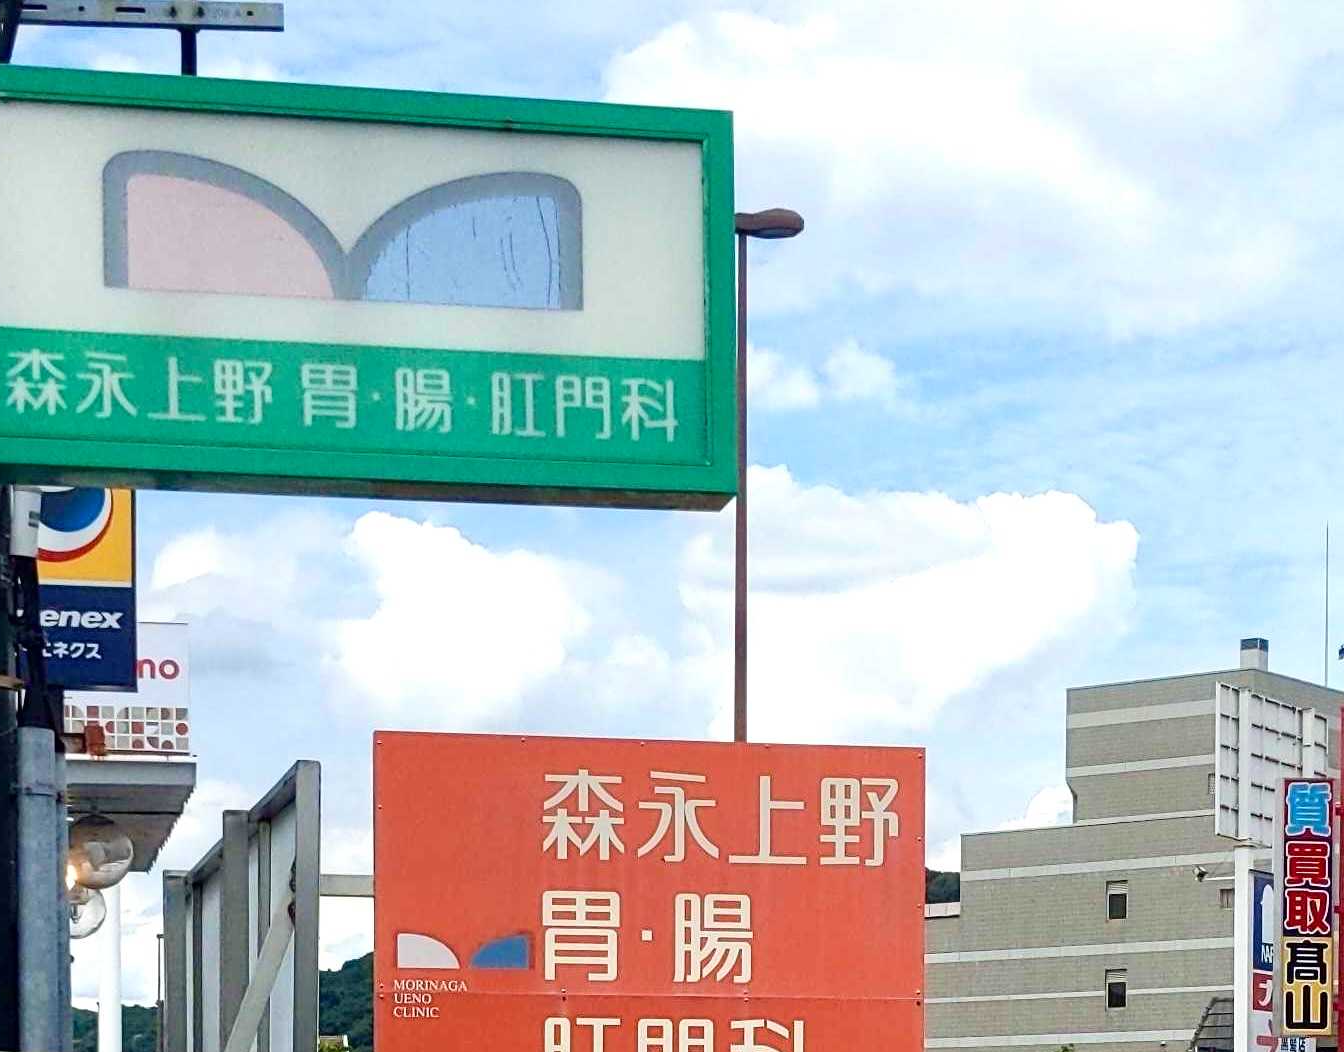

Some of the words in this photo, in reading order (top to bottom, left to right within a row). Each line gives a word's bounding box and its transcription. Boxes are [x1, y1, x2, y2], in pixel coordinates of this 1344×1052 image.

[5, 347, 273, 424] 森永上野
[542, 768, 899, 867] 森永上野
[542, 890, 753, 984] 胃・腸
[393, 979, 468, 992] MORINAGA
[393, 993, 432, 1005] UENO
[393, 1006, 439, 1018] CLINIC
